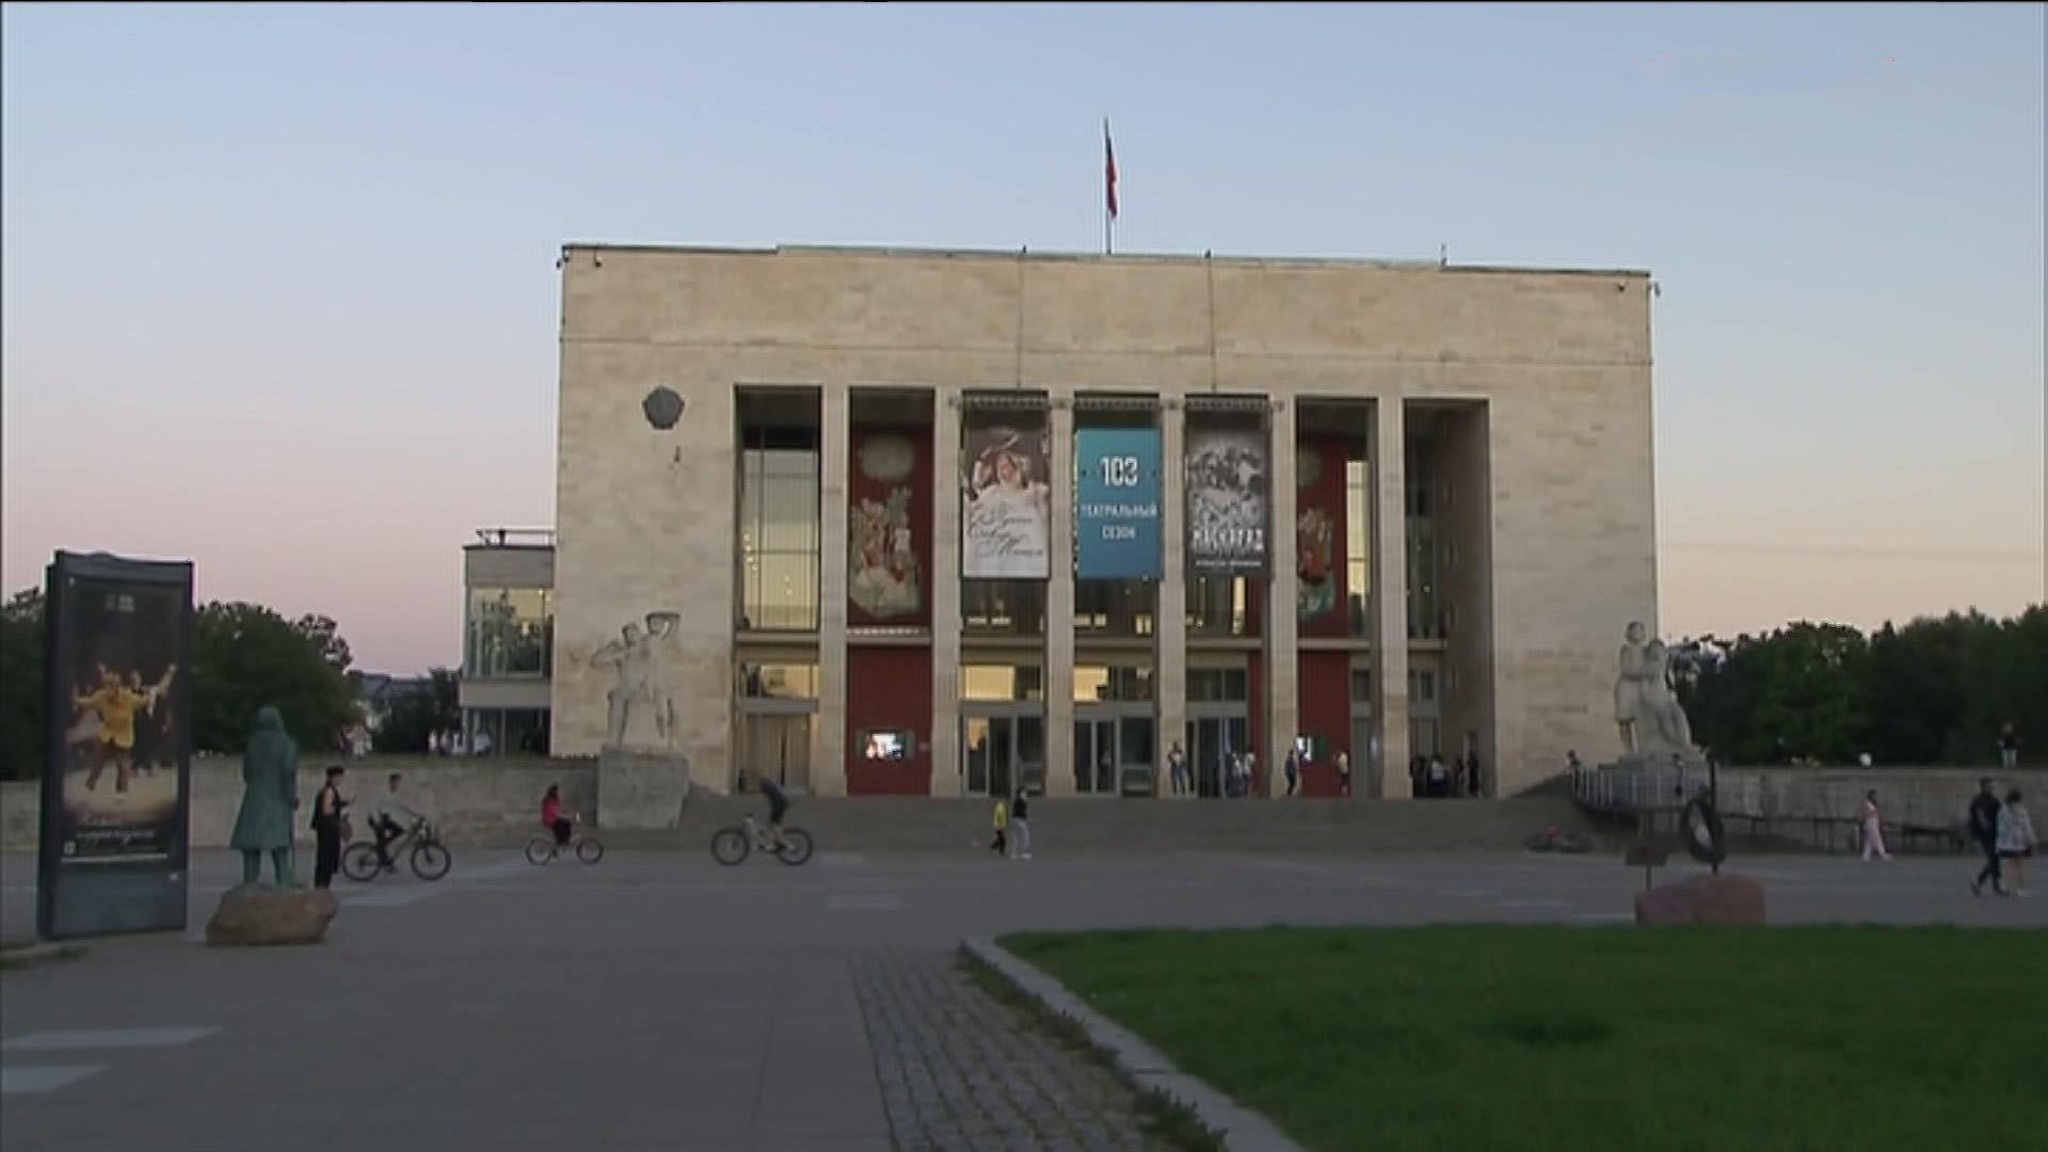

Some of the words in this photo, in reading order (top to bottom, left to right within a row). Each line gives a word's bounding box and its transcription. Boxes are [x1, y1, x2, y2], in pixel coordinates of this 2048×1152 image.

[1100, 455, 1138, 487] 103
[1080, 502, 1157, 517] ТЕАТРАЛЬНЫЙ
[1101, 525, 1135, 540] СЕЗОН
